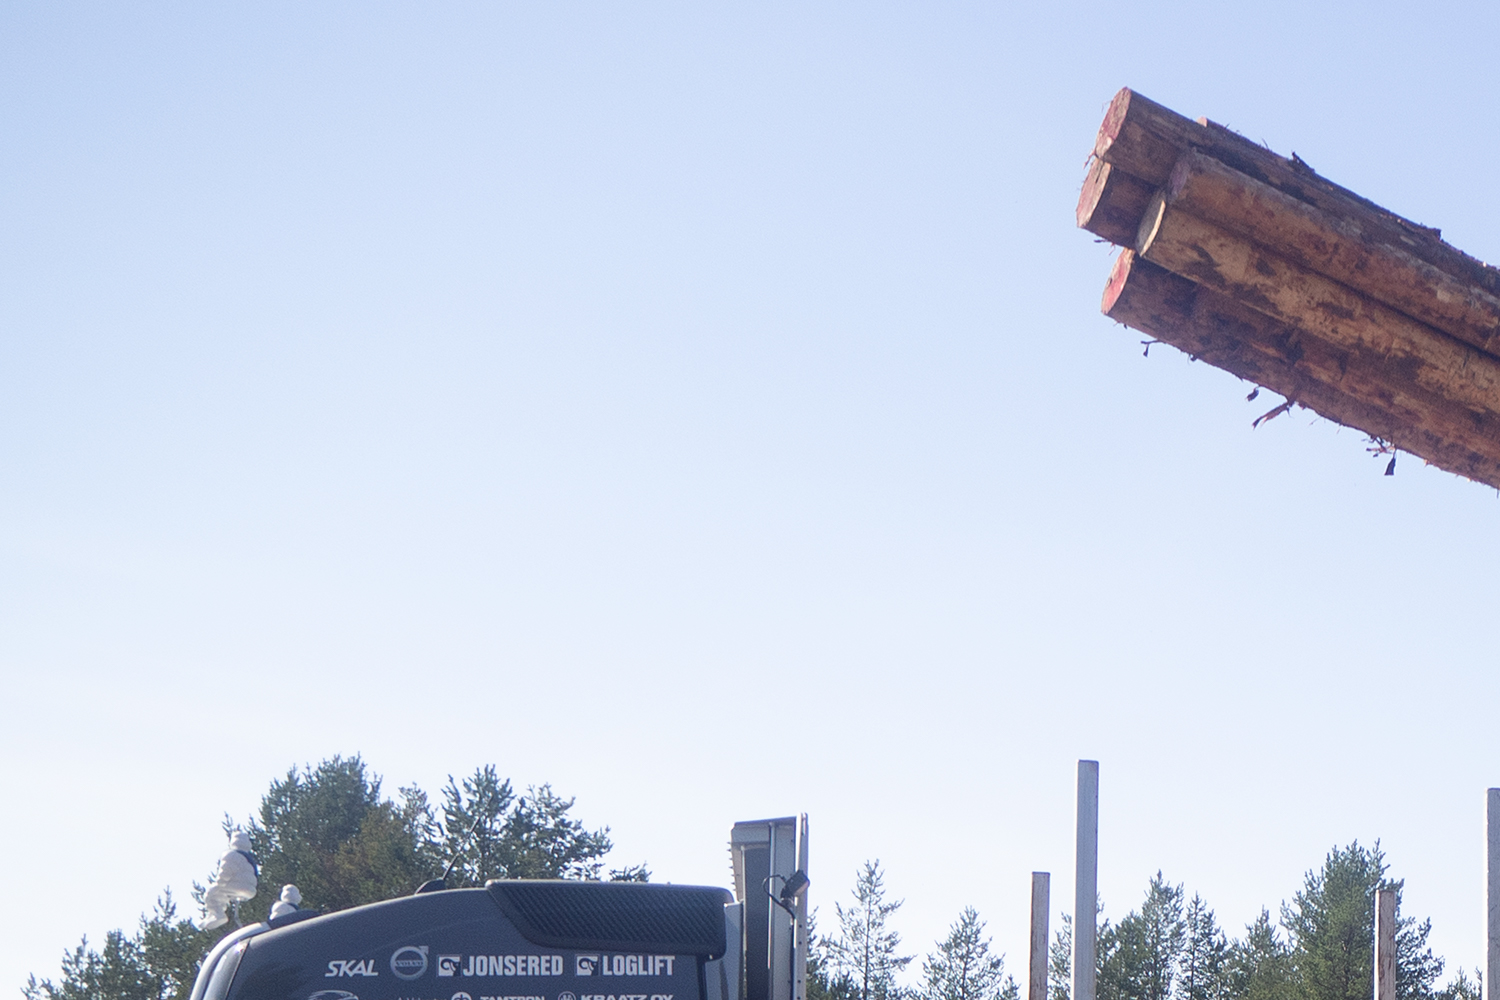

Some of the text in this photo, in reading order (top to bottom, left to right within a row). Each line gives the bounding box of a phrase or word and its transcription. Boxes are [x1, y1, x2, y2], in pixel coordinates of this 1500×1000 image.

[325, 959, 379, 977] SKAL
[463, 955, 564, 976] JONSERED
[602, 955, 675, 976] LOGLIFT
